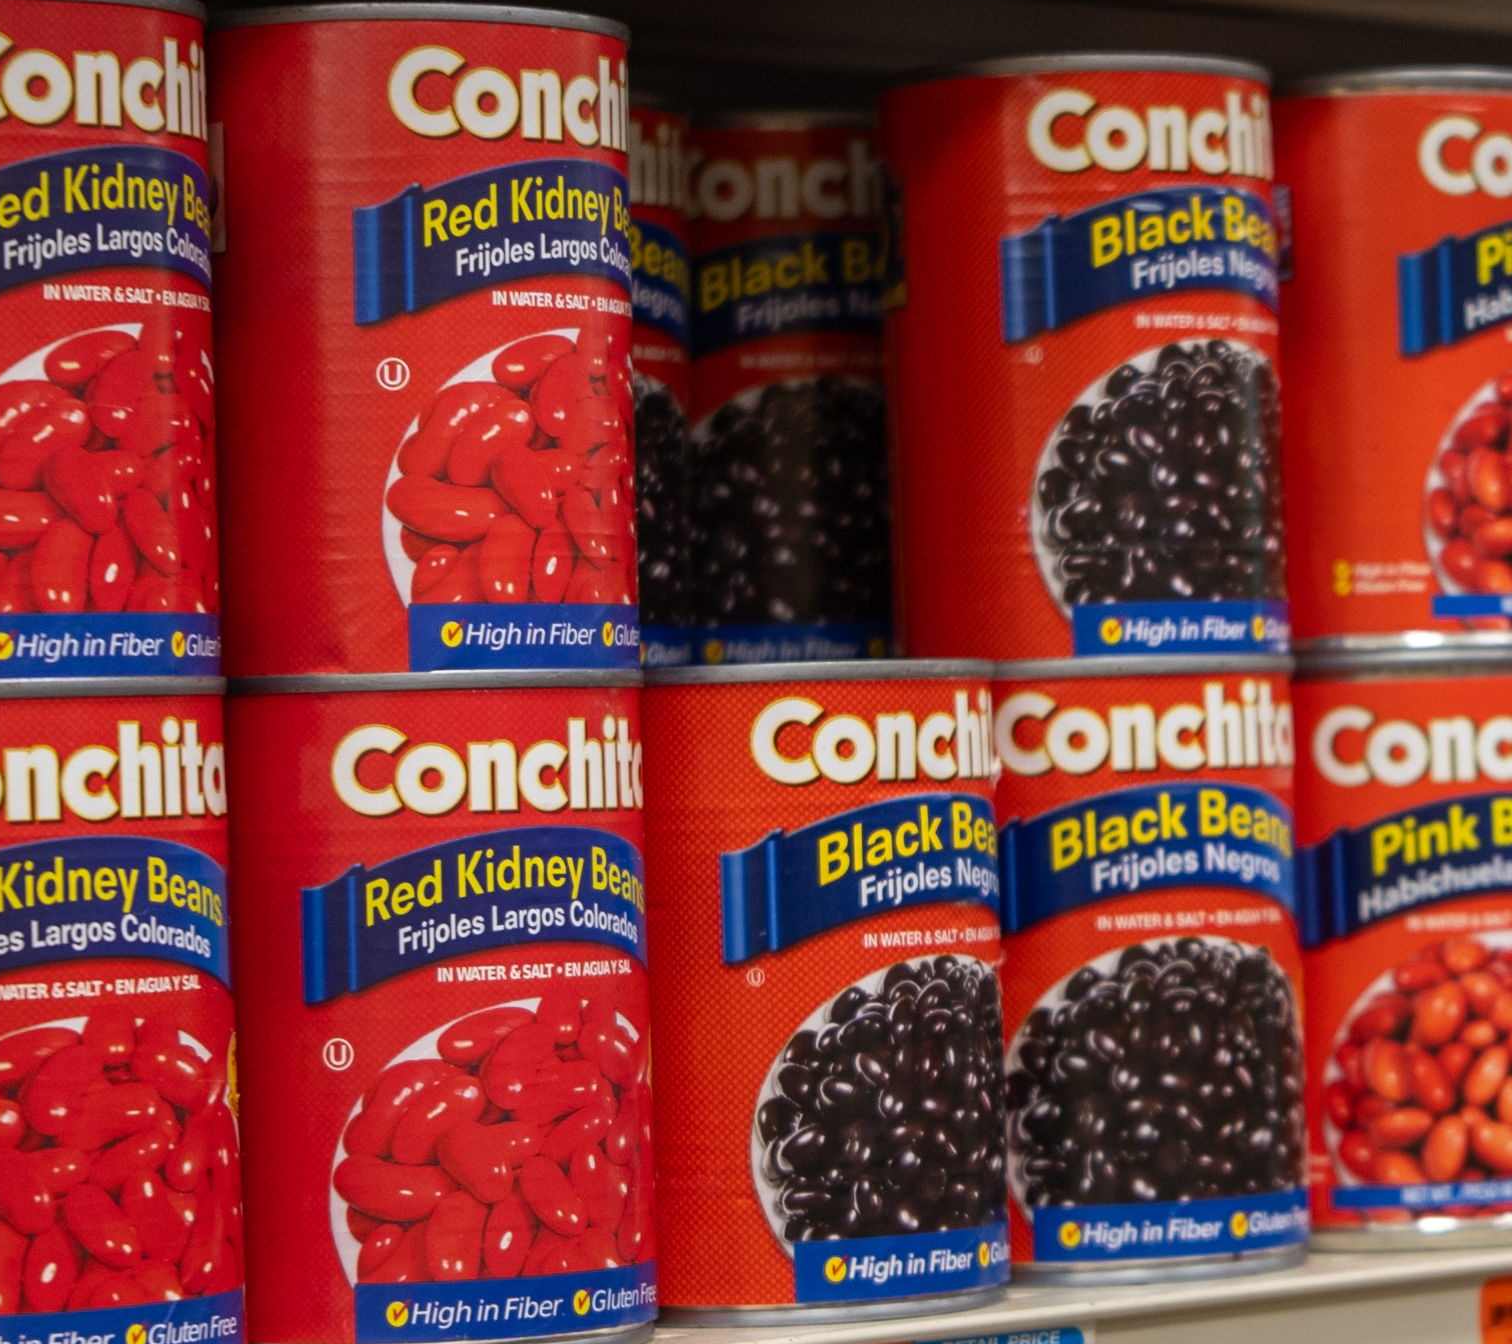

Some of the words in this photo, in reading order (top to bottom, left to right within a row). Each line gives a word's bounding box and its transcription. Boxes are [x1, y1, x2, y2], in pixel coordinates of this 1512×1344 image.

[2, 226, 93, 274] Frijoles
[97, 222, 163, 259] Largos
[455, 237, 536, 279] Frijoles
[540, 232, 598, 280] Largos
[464, 621, 521, 650] High
[525, 621, 547, 647] in
[550, 619, 597, 649] Fiber
[1123, 618, 1174, 645] High
[1178, 618, 1198, 641] in
[1201, 616, 1246, 642] Fiber
[1049, 792, 1189, 875] Black
[1198, 787, 1291, 857] Beans
[858, 865, 952, 913] Frijoles
[1091, 850, 1201, 897] Frijoles
[1204, 844, 1281, 887] Negros
[30, 918, 117, 958] Largos
[119, 913, 213, 960] Colorados
[437, 965, 452, 984] IN
[456, 963, 507, 984] WATER
[521, 962, 555, 981] SALT
[564, 961, 581, 979] EN
[209, 1312, 238, 1340] Free
